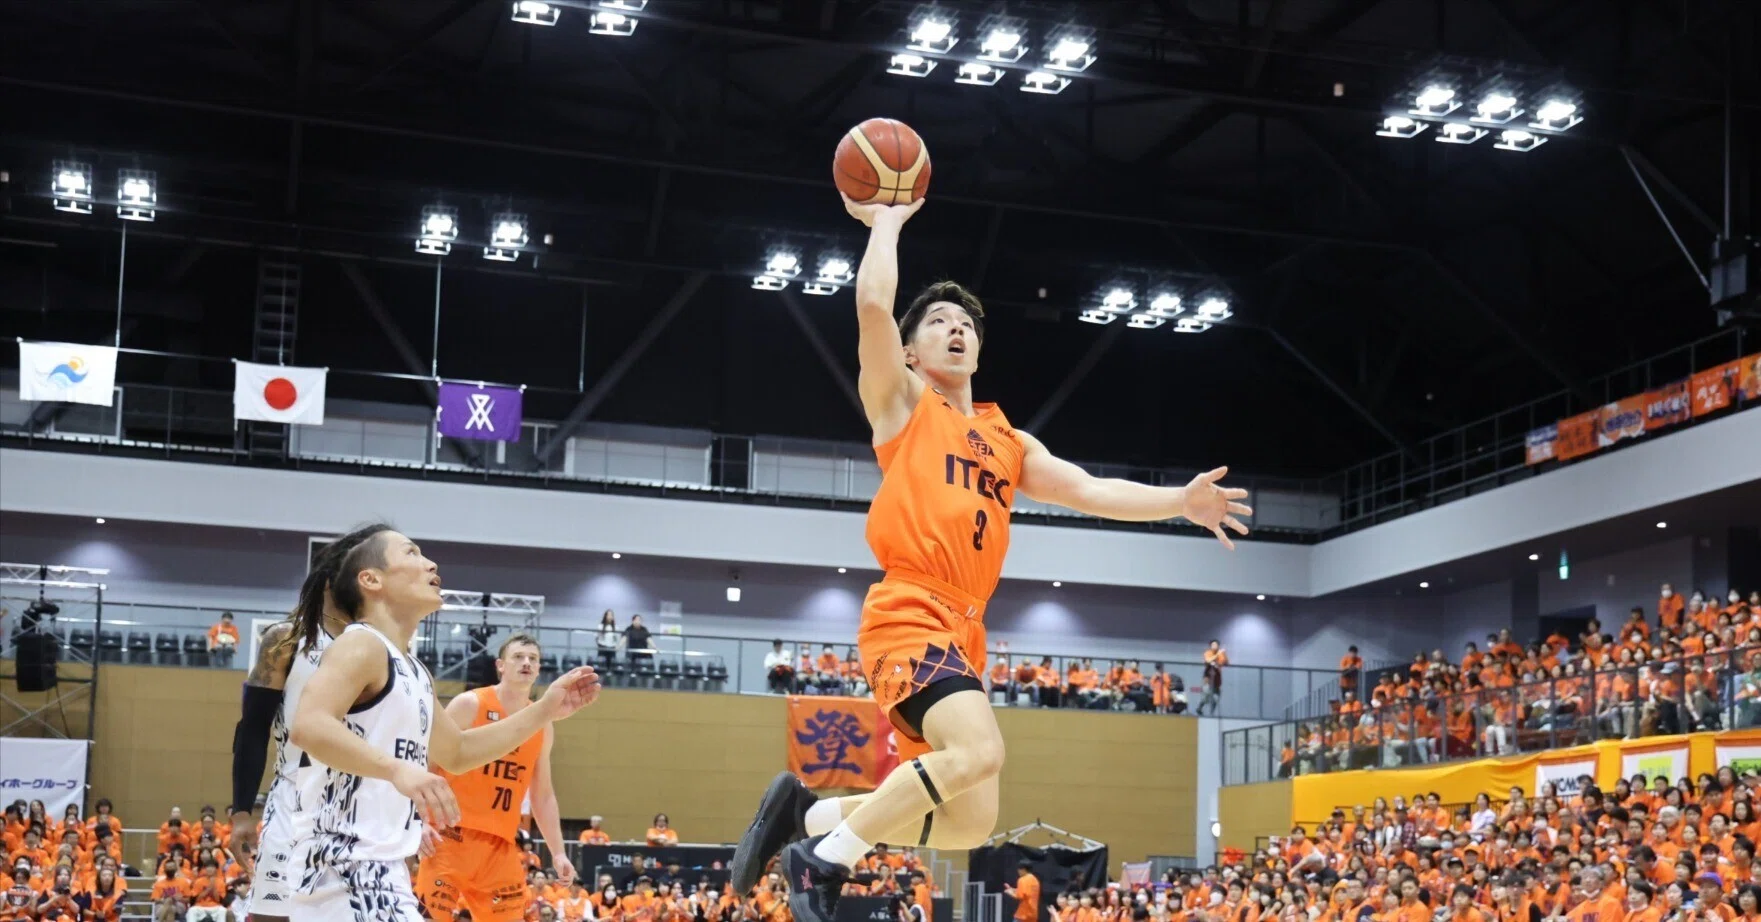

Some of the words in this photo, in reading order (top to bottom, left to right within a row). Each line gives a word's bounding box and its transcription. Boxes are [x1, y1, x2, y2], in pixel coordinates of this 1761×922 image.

[945, 453, 1011, 508] ITEC
[972, 509, 988, 551] 3
[796, 709, 871, 775] 登
[491, 786, 513, 812] 70
